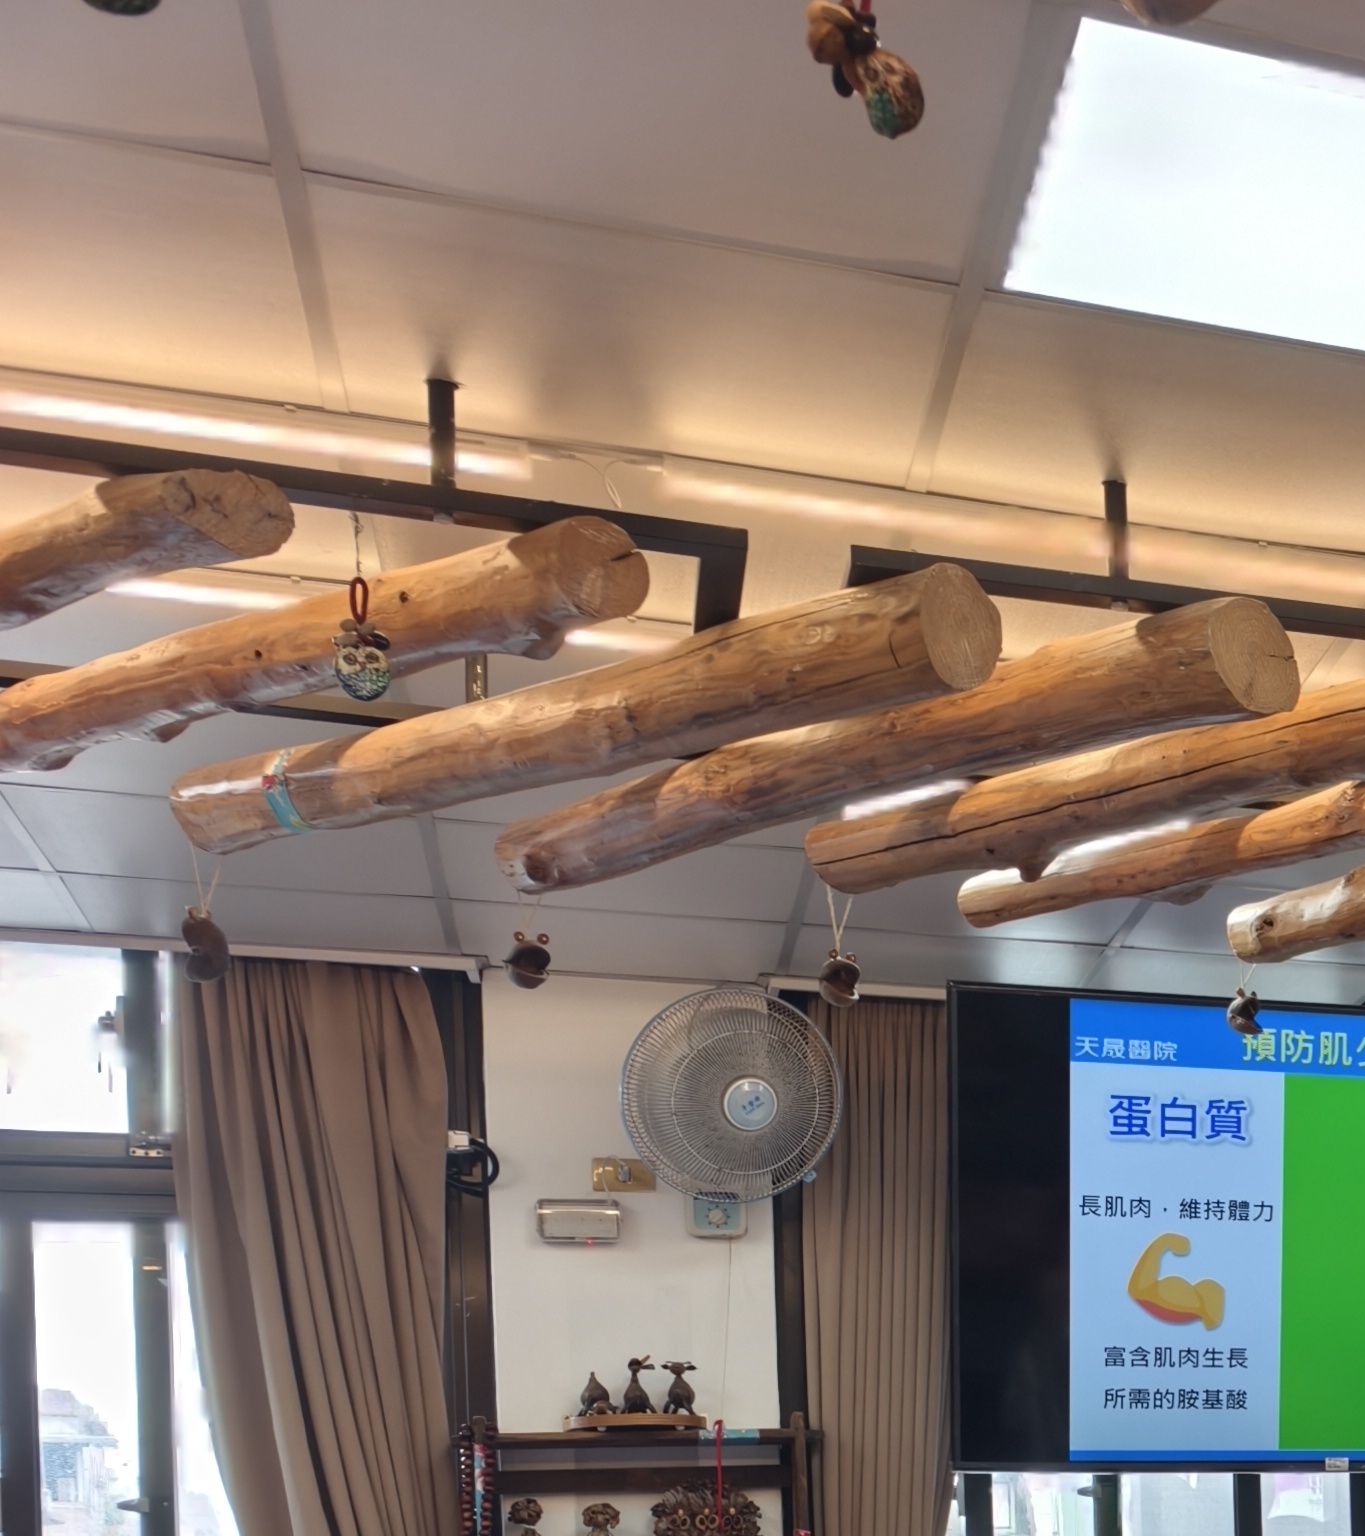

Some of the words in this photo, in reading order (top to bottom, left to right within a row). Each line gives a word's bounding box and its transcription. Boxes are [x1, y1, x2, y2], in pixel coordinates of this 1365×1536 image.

[1075, 1036, 1178, 1062] 天晟醫院
[1109, 1094, 1248, 1142] 蛋白質
[1103, 1345, 1250, 1370] 富含肌肉生長
[1103, 1387, 1249, 1411] 所需的胺基酸
